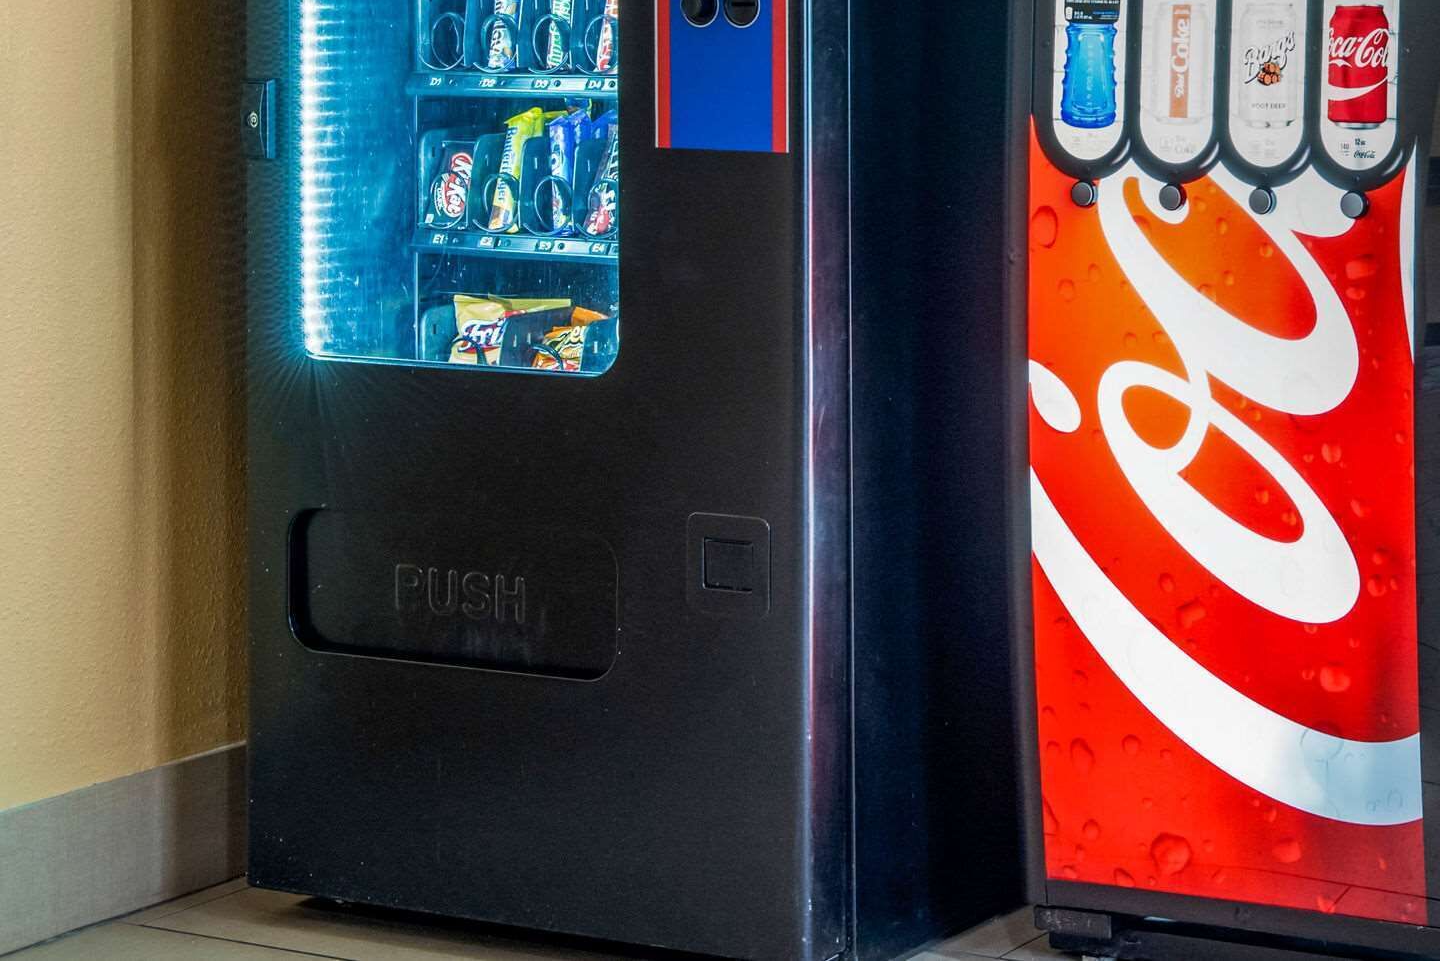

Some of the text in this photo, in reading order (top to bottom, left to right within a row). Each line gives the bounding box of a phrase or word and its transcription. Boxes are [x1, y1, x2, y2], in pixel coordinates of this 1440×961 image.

[1172, 18, 1190, 74] Coke
[1328, 27, 1390, 68] oca-Col
[588, 77, 601, 88] D4
[498, 124, 517, 206] Butterfger
[446, 181, 467, 216] Kat
[394, 563, 527, 624] PUSH
